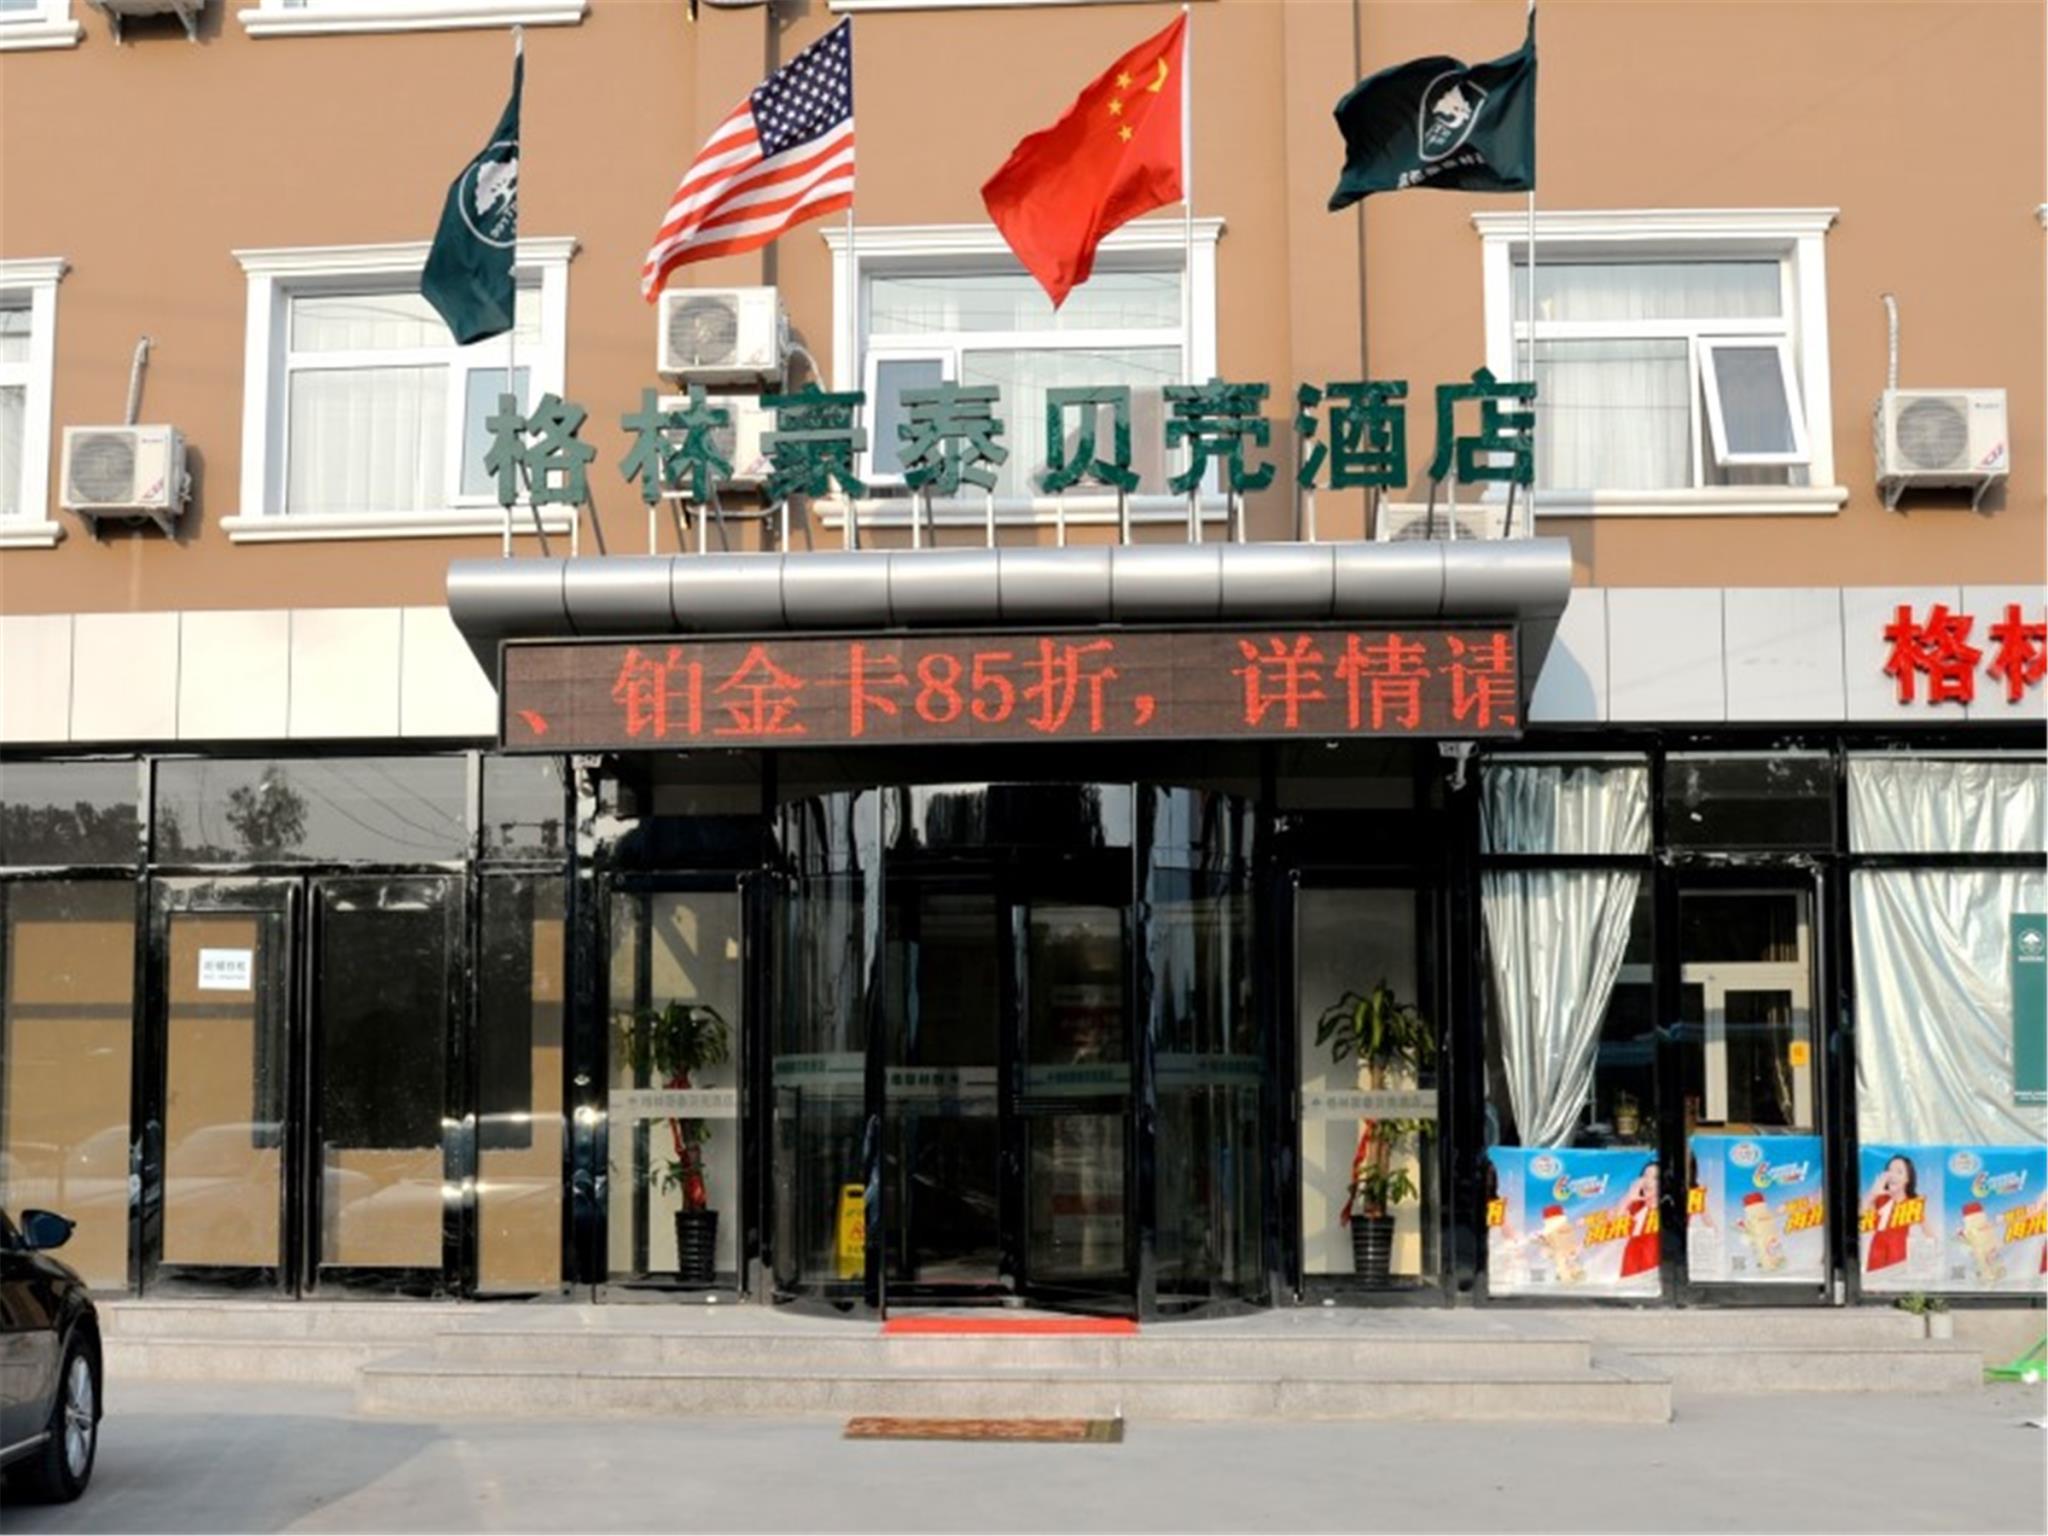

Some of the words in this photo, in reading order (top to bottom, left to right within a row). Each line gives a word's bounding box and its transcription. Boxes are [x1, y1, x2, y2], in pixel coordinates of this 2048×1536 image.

[484, 367, 1537, 506] 格林豪泰贝壳酒店
